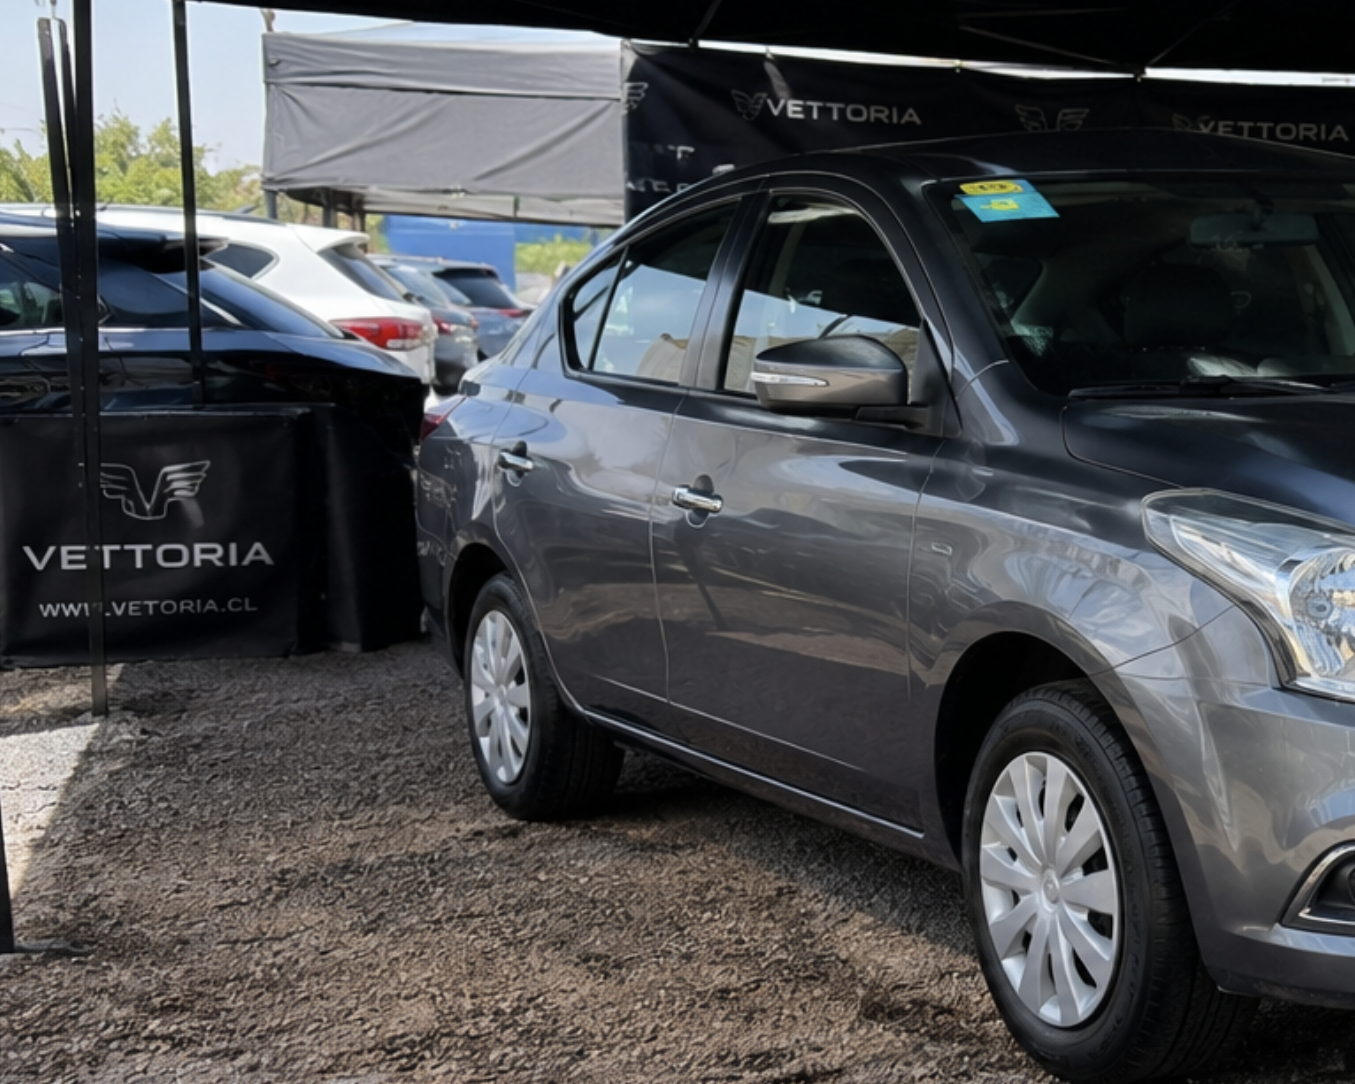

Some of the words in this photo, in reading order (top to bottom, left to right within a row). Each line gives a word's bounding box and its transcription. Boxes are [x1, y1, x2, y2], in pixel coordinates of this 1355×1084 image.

[766, 98, 922, 125] VETTORIA
[1198, 120, 1350, 142] VETTORIA
[22, 542, 274, 571] VETTORIA
[39, 598, 258, 617] WW.VETORIA.CL
